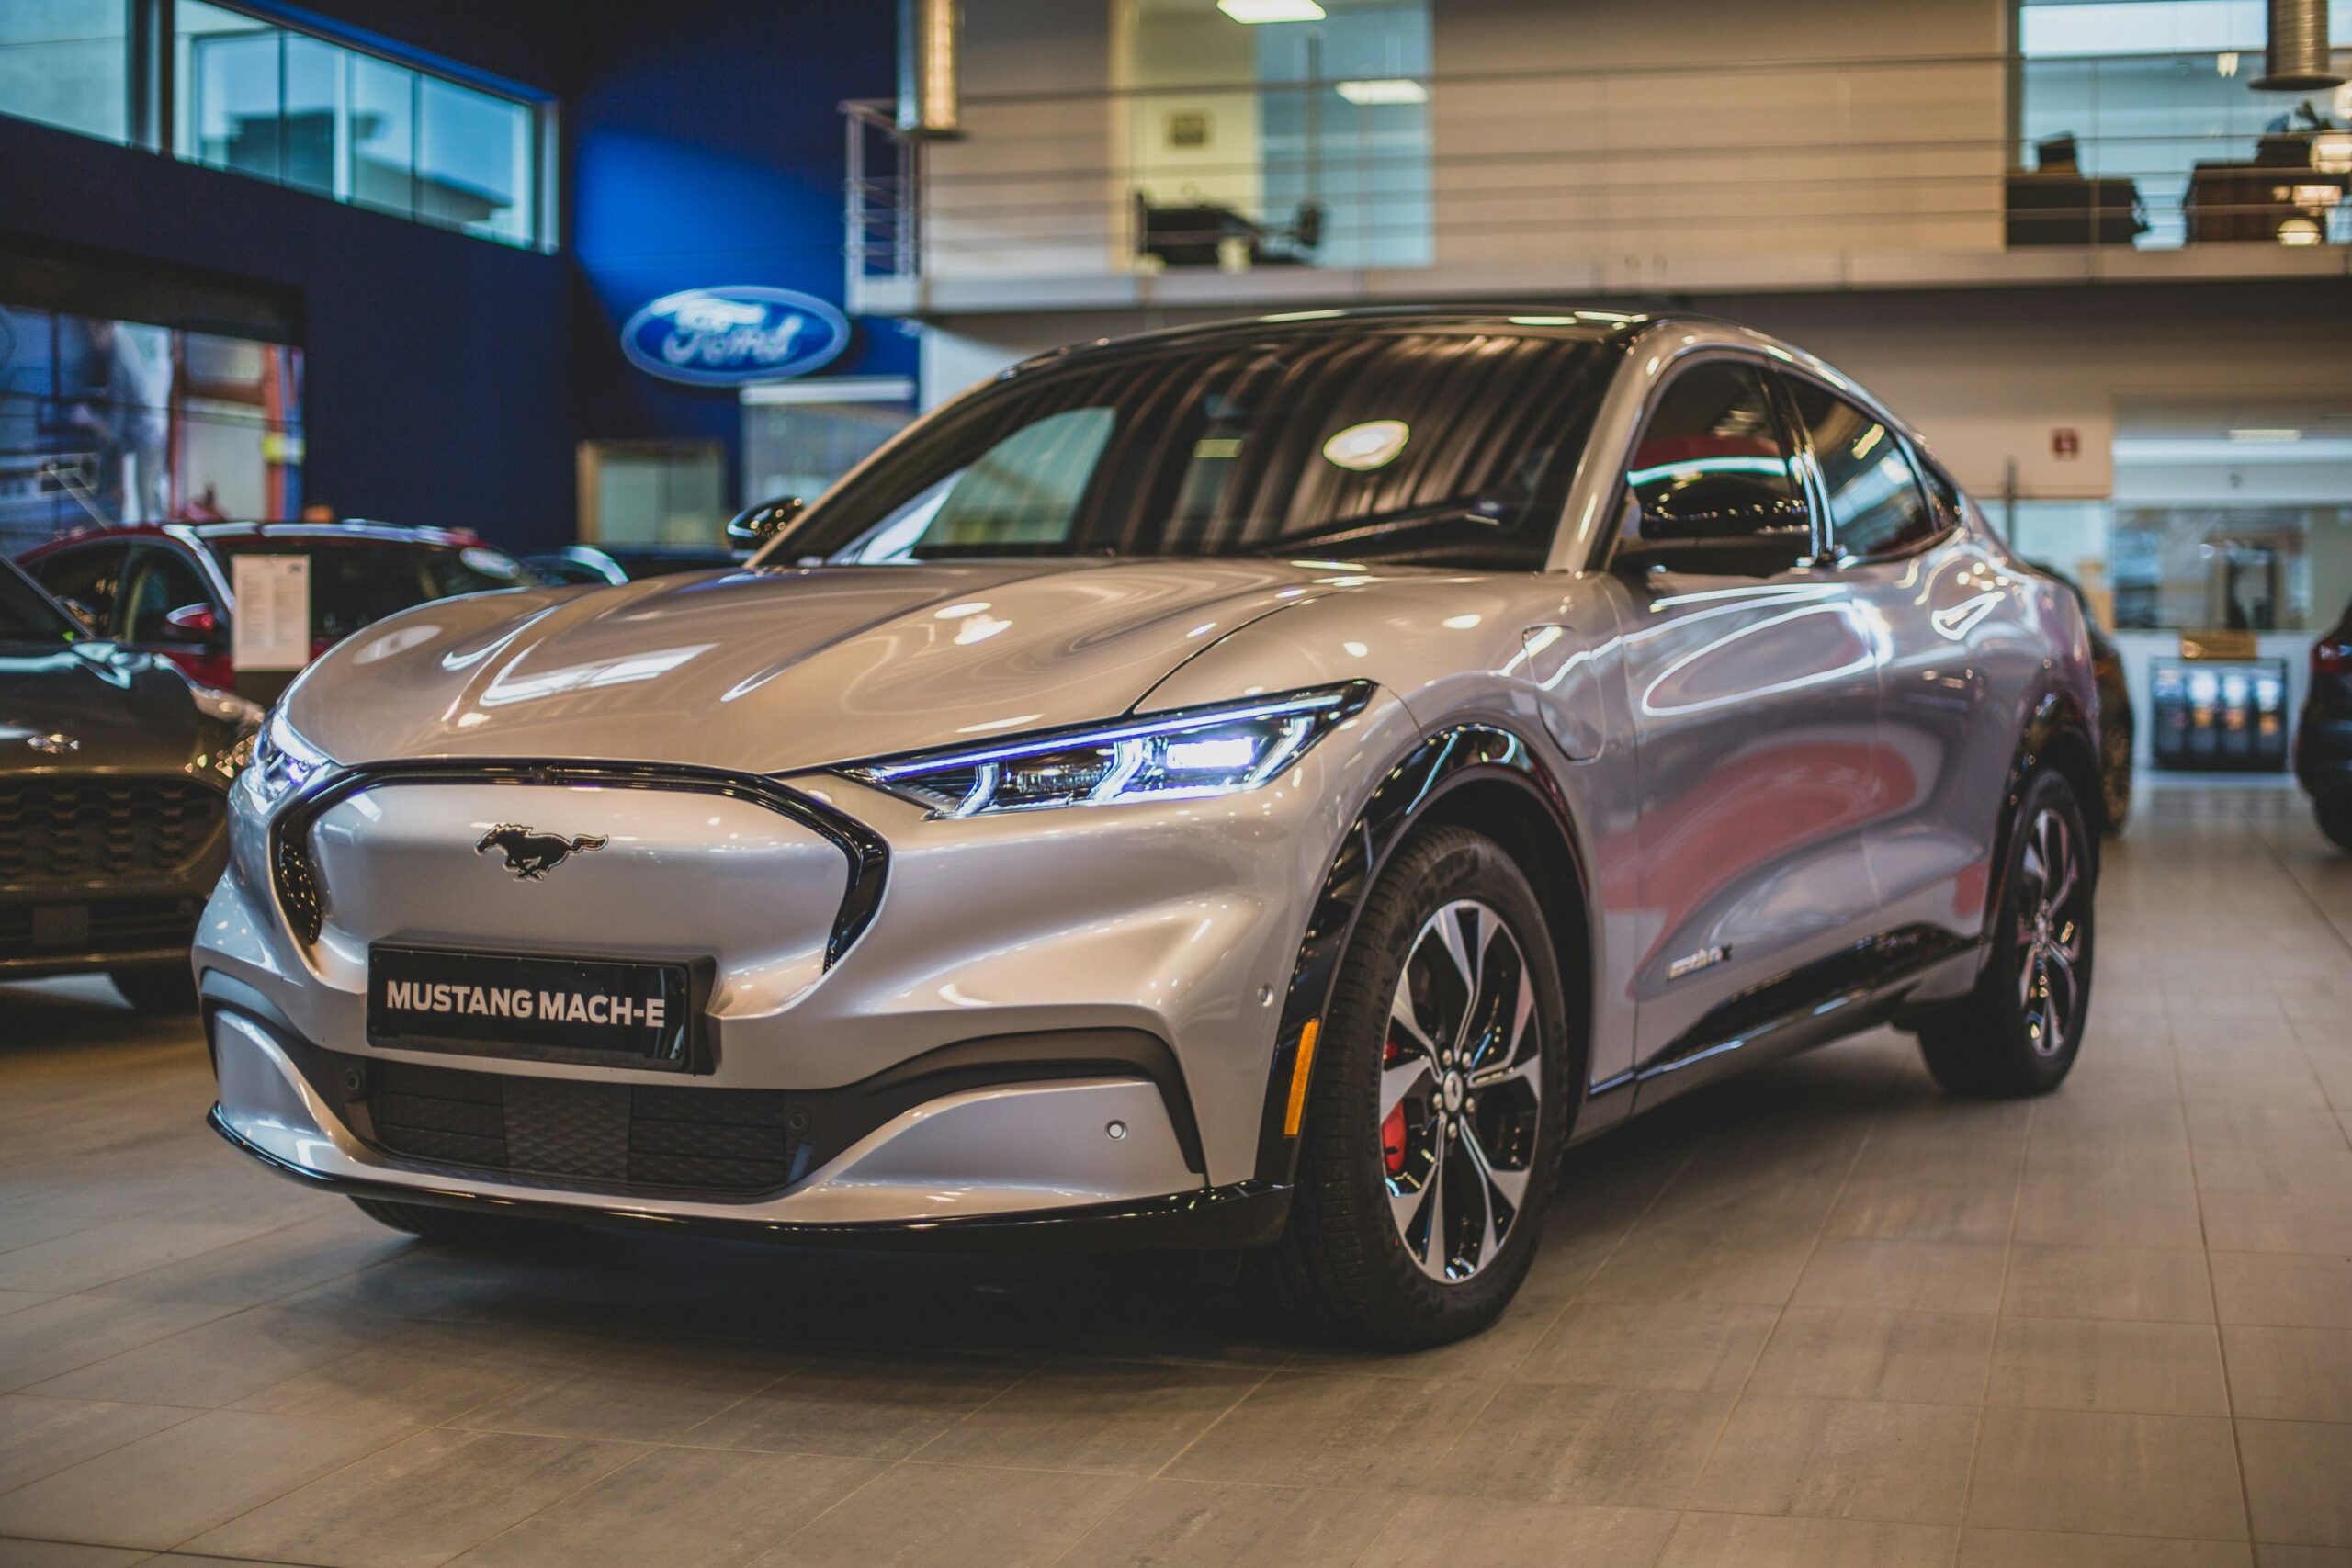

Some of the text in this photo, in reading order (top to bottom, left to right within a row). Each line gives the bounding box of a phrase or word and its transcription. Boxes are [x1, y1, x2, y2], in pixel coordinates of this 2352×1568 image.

[662, 298, 803, 365] Ford
[386, 980, 666, 1028] MUSTANG MACH-E
